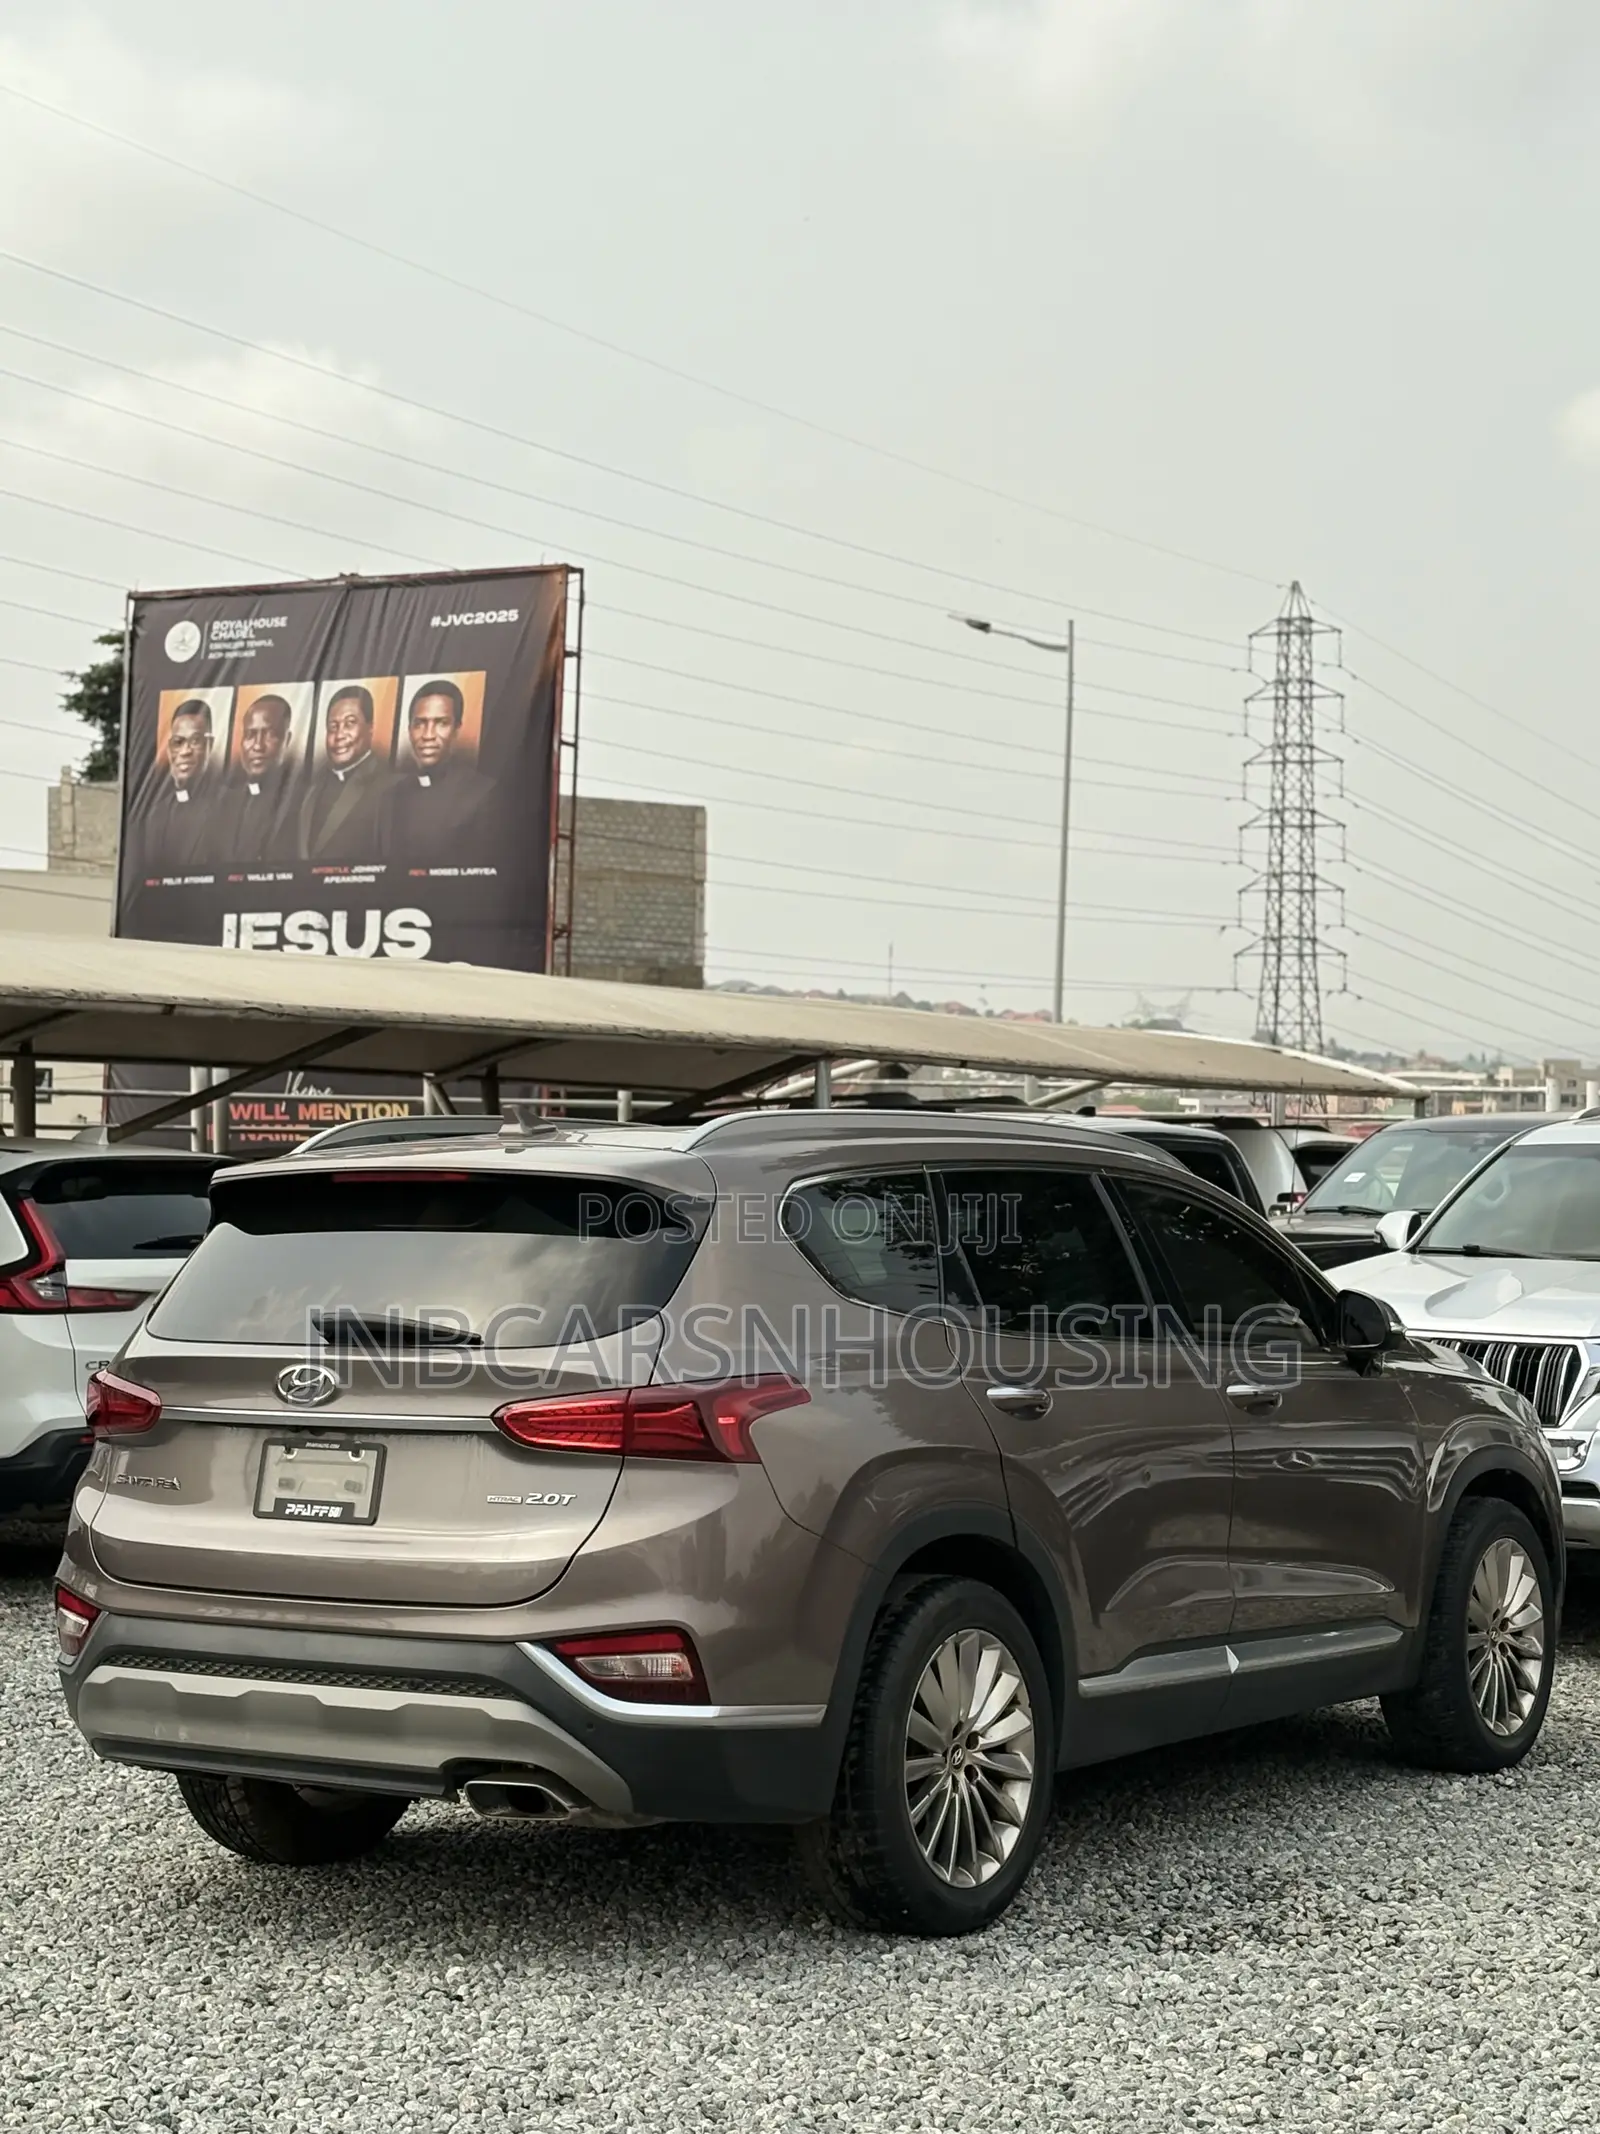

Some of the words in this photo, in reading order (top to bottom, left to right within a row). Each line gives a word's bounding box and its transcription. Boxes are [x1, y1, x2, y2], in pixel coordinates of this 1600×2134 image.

[212, 616, 288, 630] ROYALHOUSE
[430, 608, 519, 628] #JVC2025
[229, 1102, 290, 1120] WILL
[298, 1102, 410, 1120] MENTION
